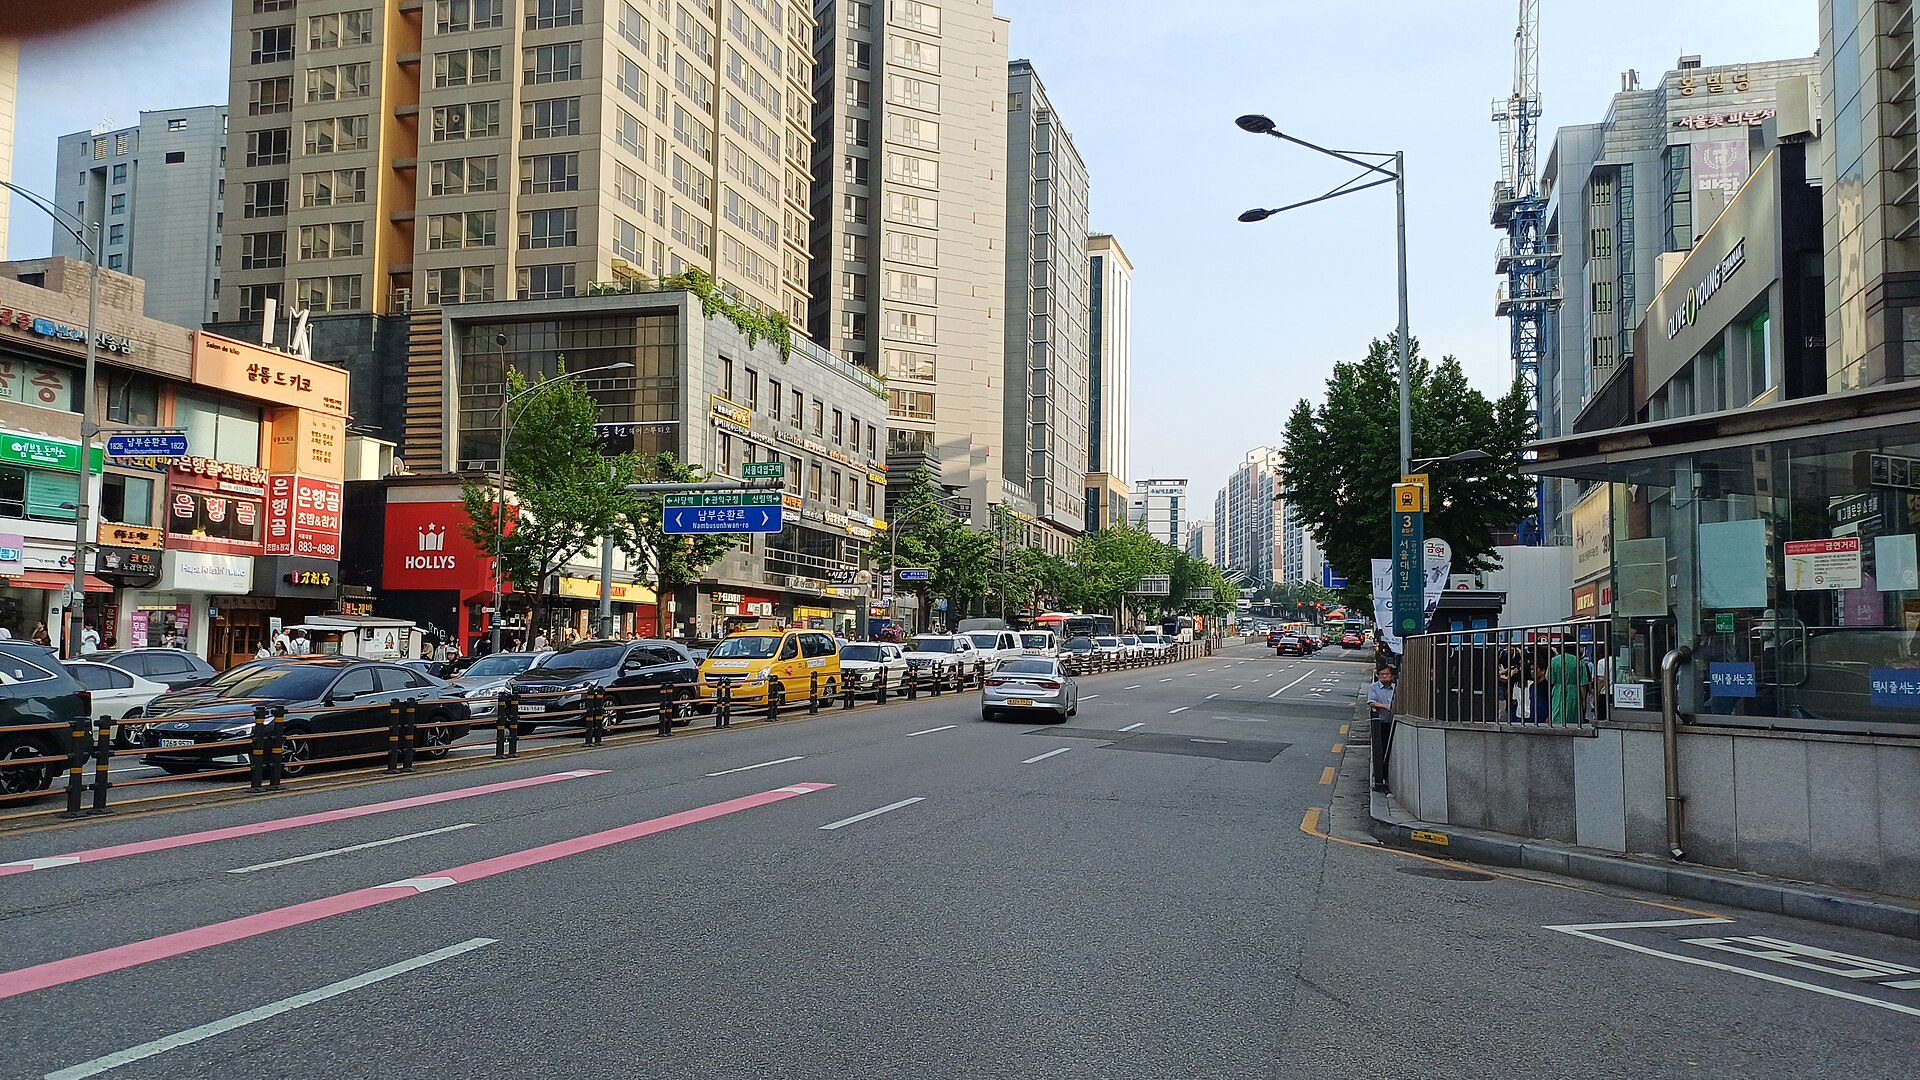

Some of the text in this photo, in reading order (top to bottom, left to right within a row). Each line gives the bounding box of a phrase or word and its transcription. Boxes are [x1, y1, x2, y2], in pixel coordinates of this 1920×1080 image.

[1668, 301, 1686, 340] OLIVE
[1695, 264, 1721, 311] YOUNG
[127, 438, 168, 447] 남부순환로
[178, 454, 269, 485] 은행골 초밥&참치
[744, 464, 781, 475] 서울대입구역
[297, 486, 340, 513] 은행골
[673, 496, 694, 505] 사당역
[711, 495, 739, 505] 관악구청
[751, 494, 773, 503] 신림역
[172, 493, 256, 526] 은행골
[271, 478, 289, 537] 은행골
[297, 511, 339, 530] 초밥&참치
[697, 509, 746, 521] 남부순환로
[1403, 515, 1412, 528] 3
[298, 540, 336, 555] 883-4988
[1426, 543, 1445, 558] 금연
[1824, 540, 1857, 551] 금연거리
[129, 553, 148, 563] 코인
[405, 556, 456, 570] HOLLYS
[1400, 540, 1410, 591] 서울대입구
[301, 571, 331, 585] 刀削面
[717, 591, 741, 603] 7-ELEVEN
[1712, 674, 1725, 684] 택시
[1732, 674, 1746, 685] 서는
[1746, 674, 1754, 686] 곳
[1873, 681, 1889, 693] 택시
[1889, 682, 1897, 694] 줄
[1899, 682, 1913, 694] 서는
